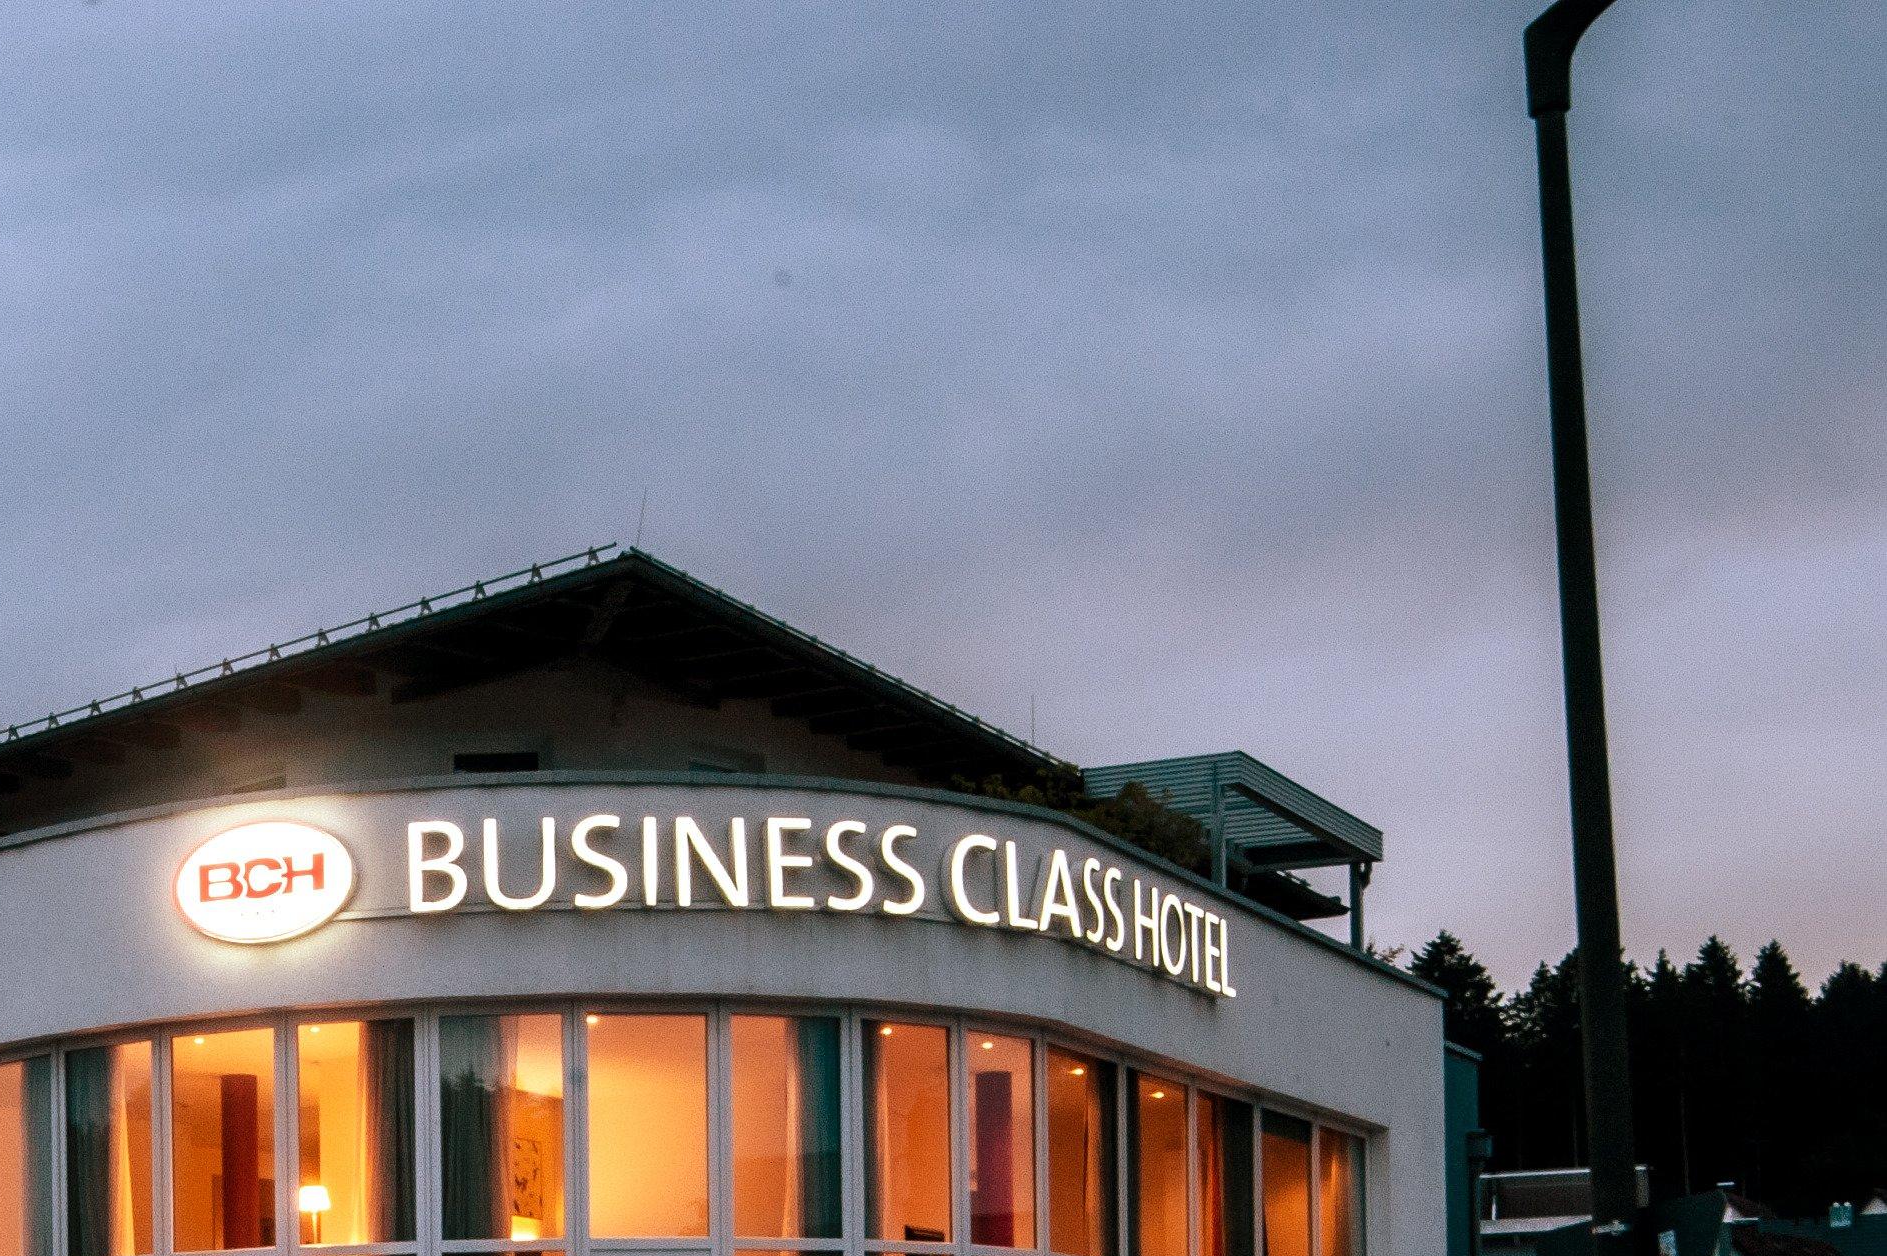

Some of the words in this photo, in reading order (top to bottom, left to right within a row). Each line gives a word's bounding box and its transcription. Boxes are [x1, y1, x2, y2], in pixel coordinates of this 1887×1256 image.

[199, 852, 325, 903] BCH
[407, 814, 926, 916] BUSINESS
[950, 834, 1125, 952] CLASS
[1133, 878, 1237, 998] HOTEL
